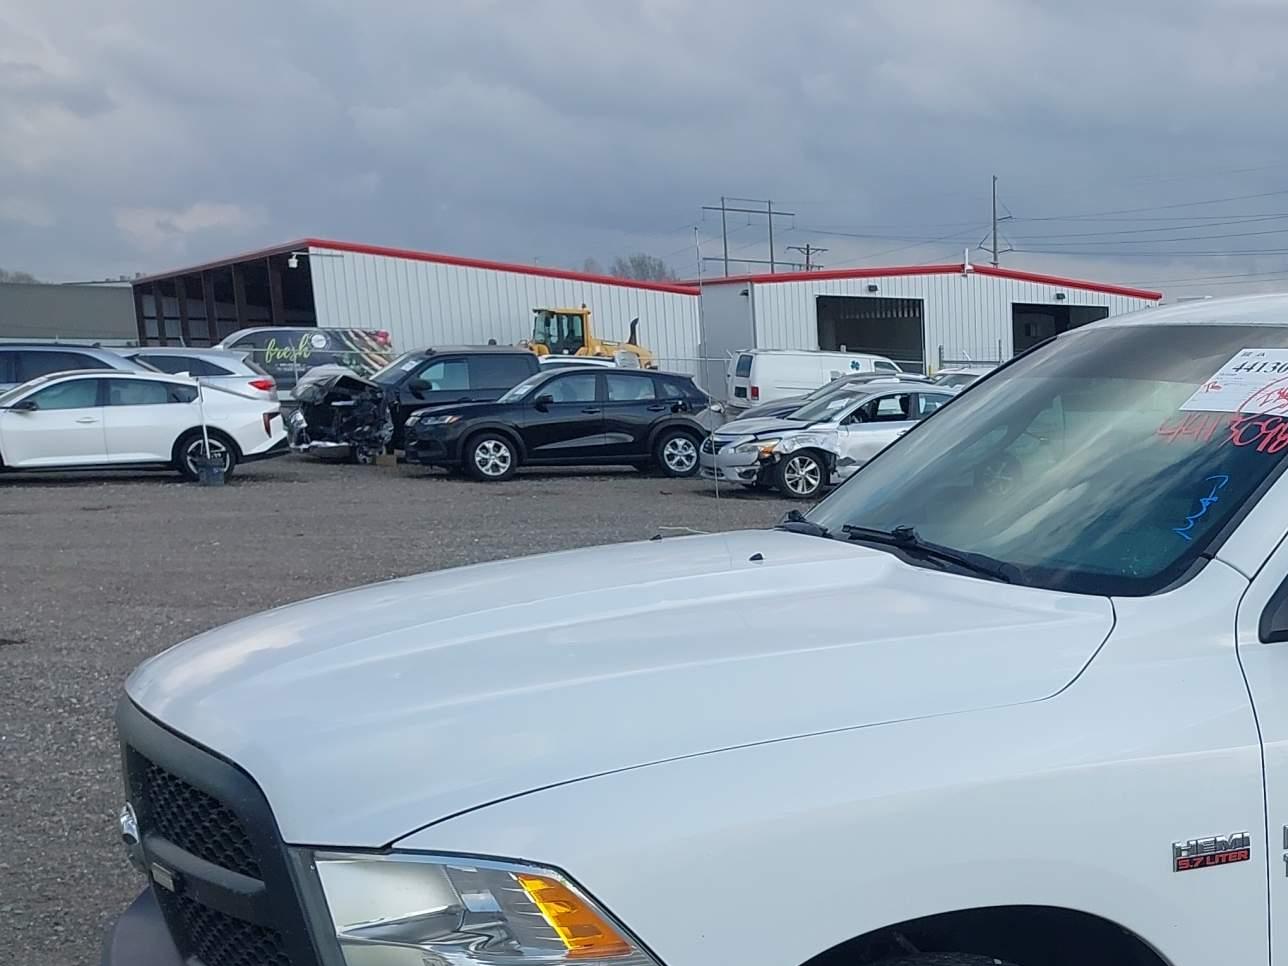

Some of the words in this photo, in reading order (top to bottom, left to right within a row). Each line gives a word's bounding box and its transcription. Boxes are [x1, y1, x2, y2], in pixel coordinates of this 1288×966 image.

[265, 333, 312, 363] fresh
[1172, 831, 1251, 858] HEMI
[1177, 857, 1205, 871] 5.7
[1205, 849, 1250, 867] LITER
